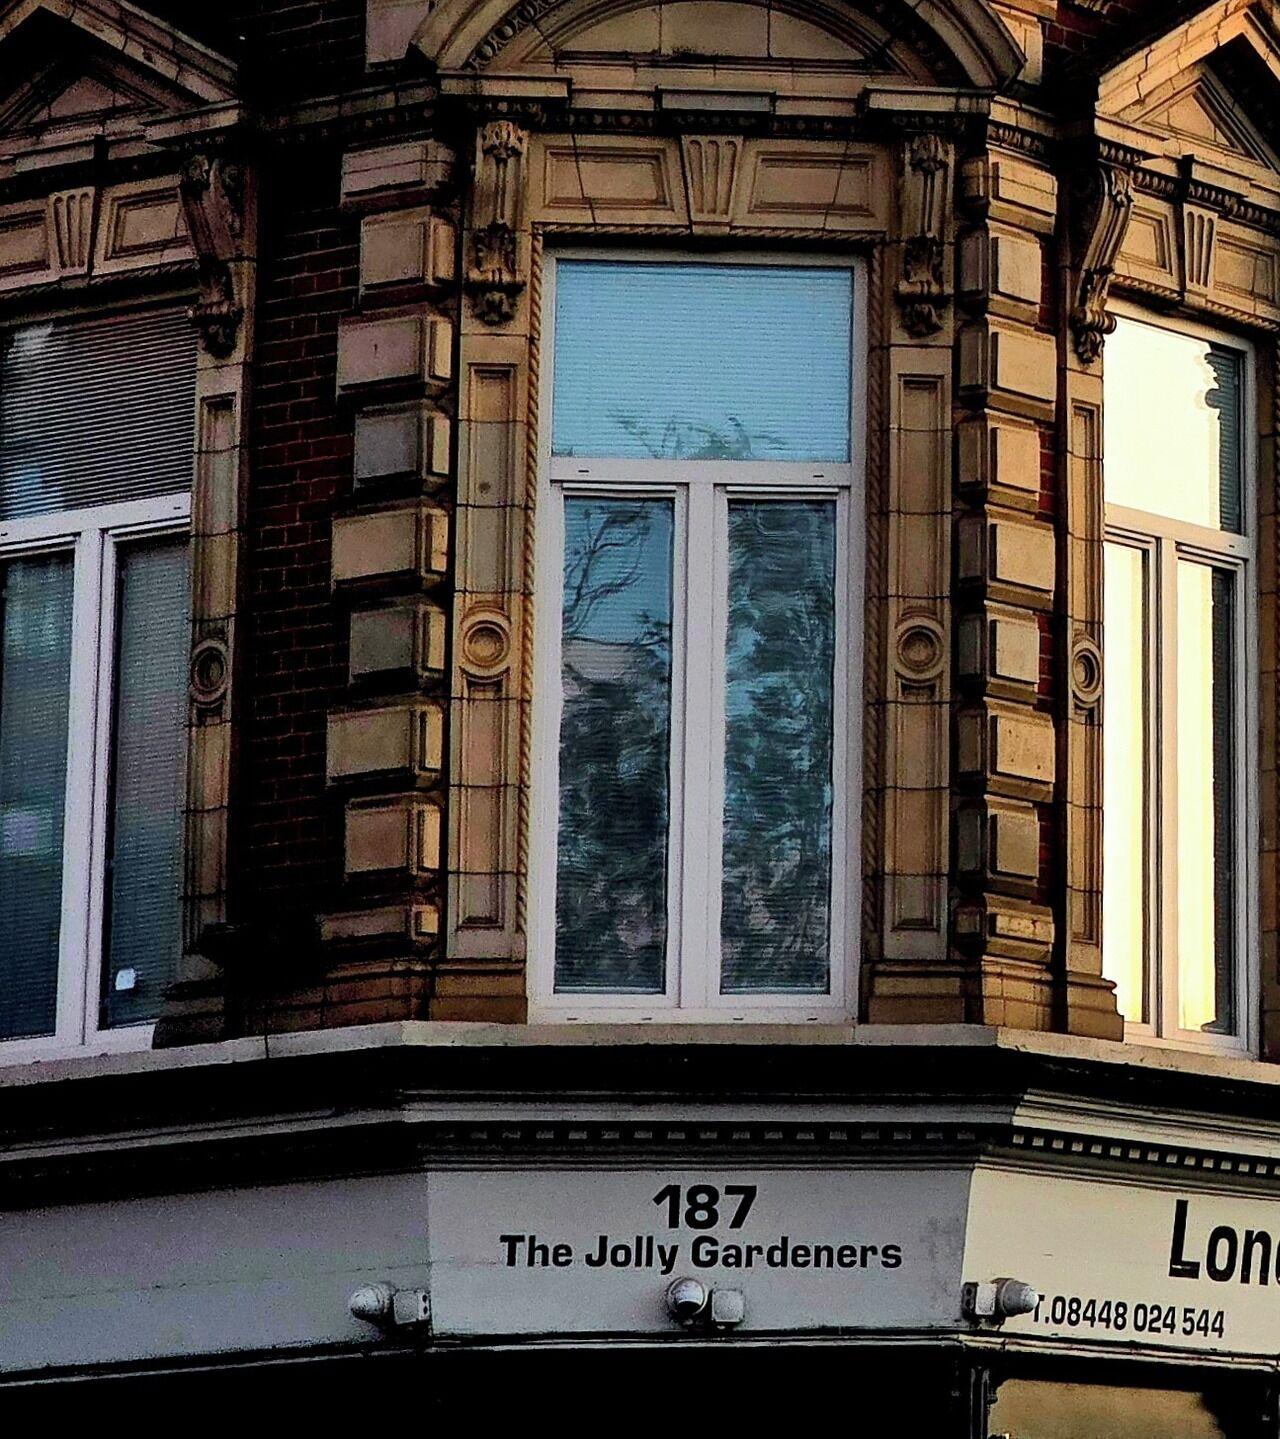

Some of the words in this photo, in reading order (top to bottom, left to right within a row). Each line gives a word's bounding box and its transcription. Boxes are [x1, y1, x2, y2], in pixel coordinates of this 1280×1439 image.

[651, 1183, 758, 1230] 187
[499, 1234, 573, 1268] The
[584, 1234, 680, 1276] Jolly
[691, 1234, 903, 1269] Gardeners
[1133, 1303, 1177, 1335] 024
[1182, 1307, 1225, 1339] 544
